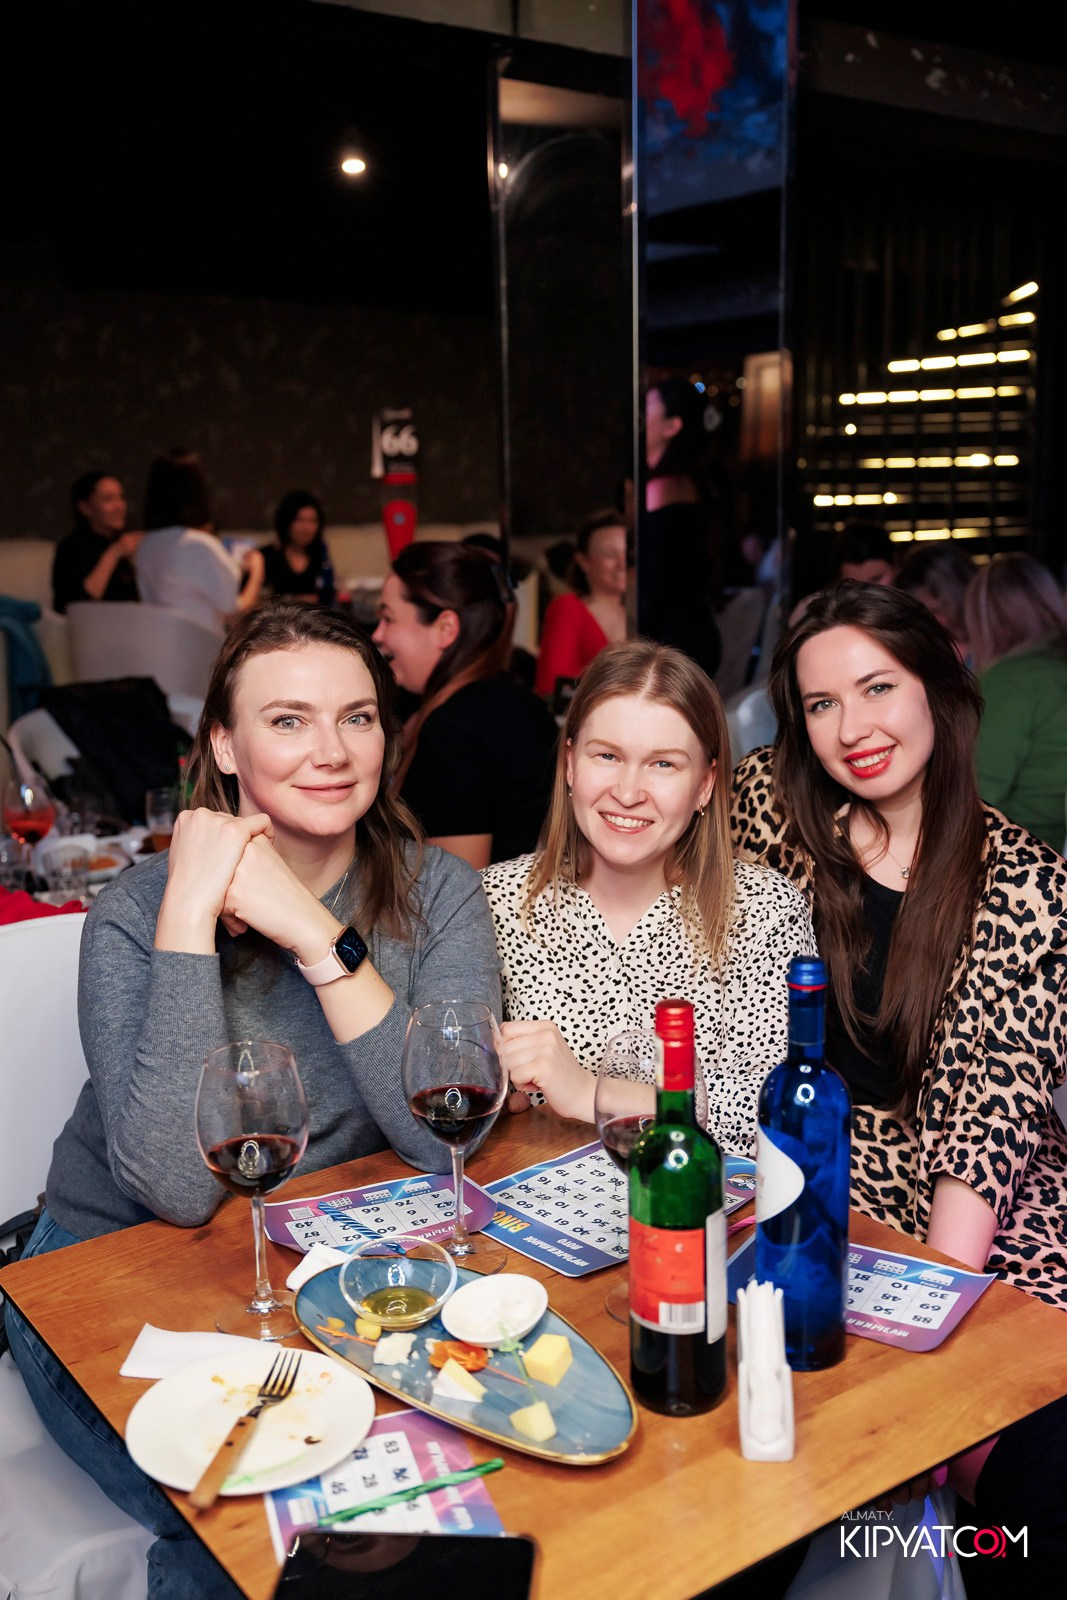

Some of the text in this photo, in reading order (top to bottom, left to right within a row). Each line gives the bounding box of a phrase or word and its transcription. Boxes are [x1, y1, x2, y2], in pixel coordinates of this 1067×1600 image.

[555, 1169, 570, 1177] 19
[537, 1177, 552, 1185] 16
[499, 1192, 515, 1200] 43
[573, 1193, 587, 1201] 12
[394, 1199, 413, 1207] 76
[516, 1200, 534, 1209] 60
[555, 1201, 570, 1209] 10
[535, 1209, 552, 1218] 35
[573, 1209, 589, 1218] 14
[610, 1210, 628, 1219] 76
[493, 1211, 532, 1234] BING
[554, 1218, 569, 1226] 61
[377, 1226, 397, 1235] 60
[342, 1234, 362, 1242] 62
[891, 1282, 909, 1291] 10
[881, 1293, 902, 1302] 48
[928, 1290, 950, 1300] 39
[873, 1305, 894, 1315] 56
[919, 1302, 942, 1312] 69
